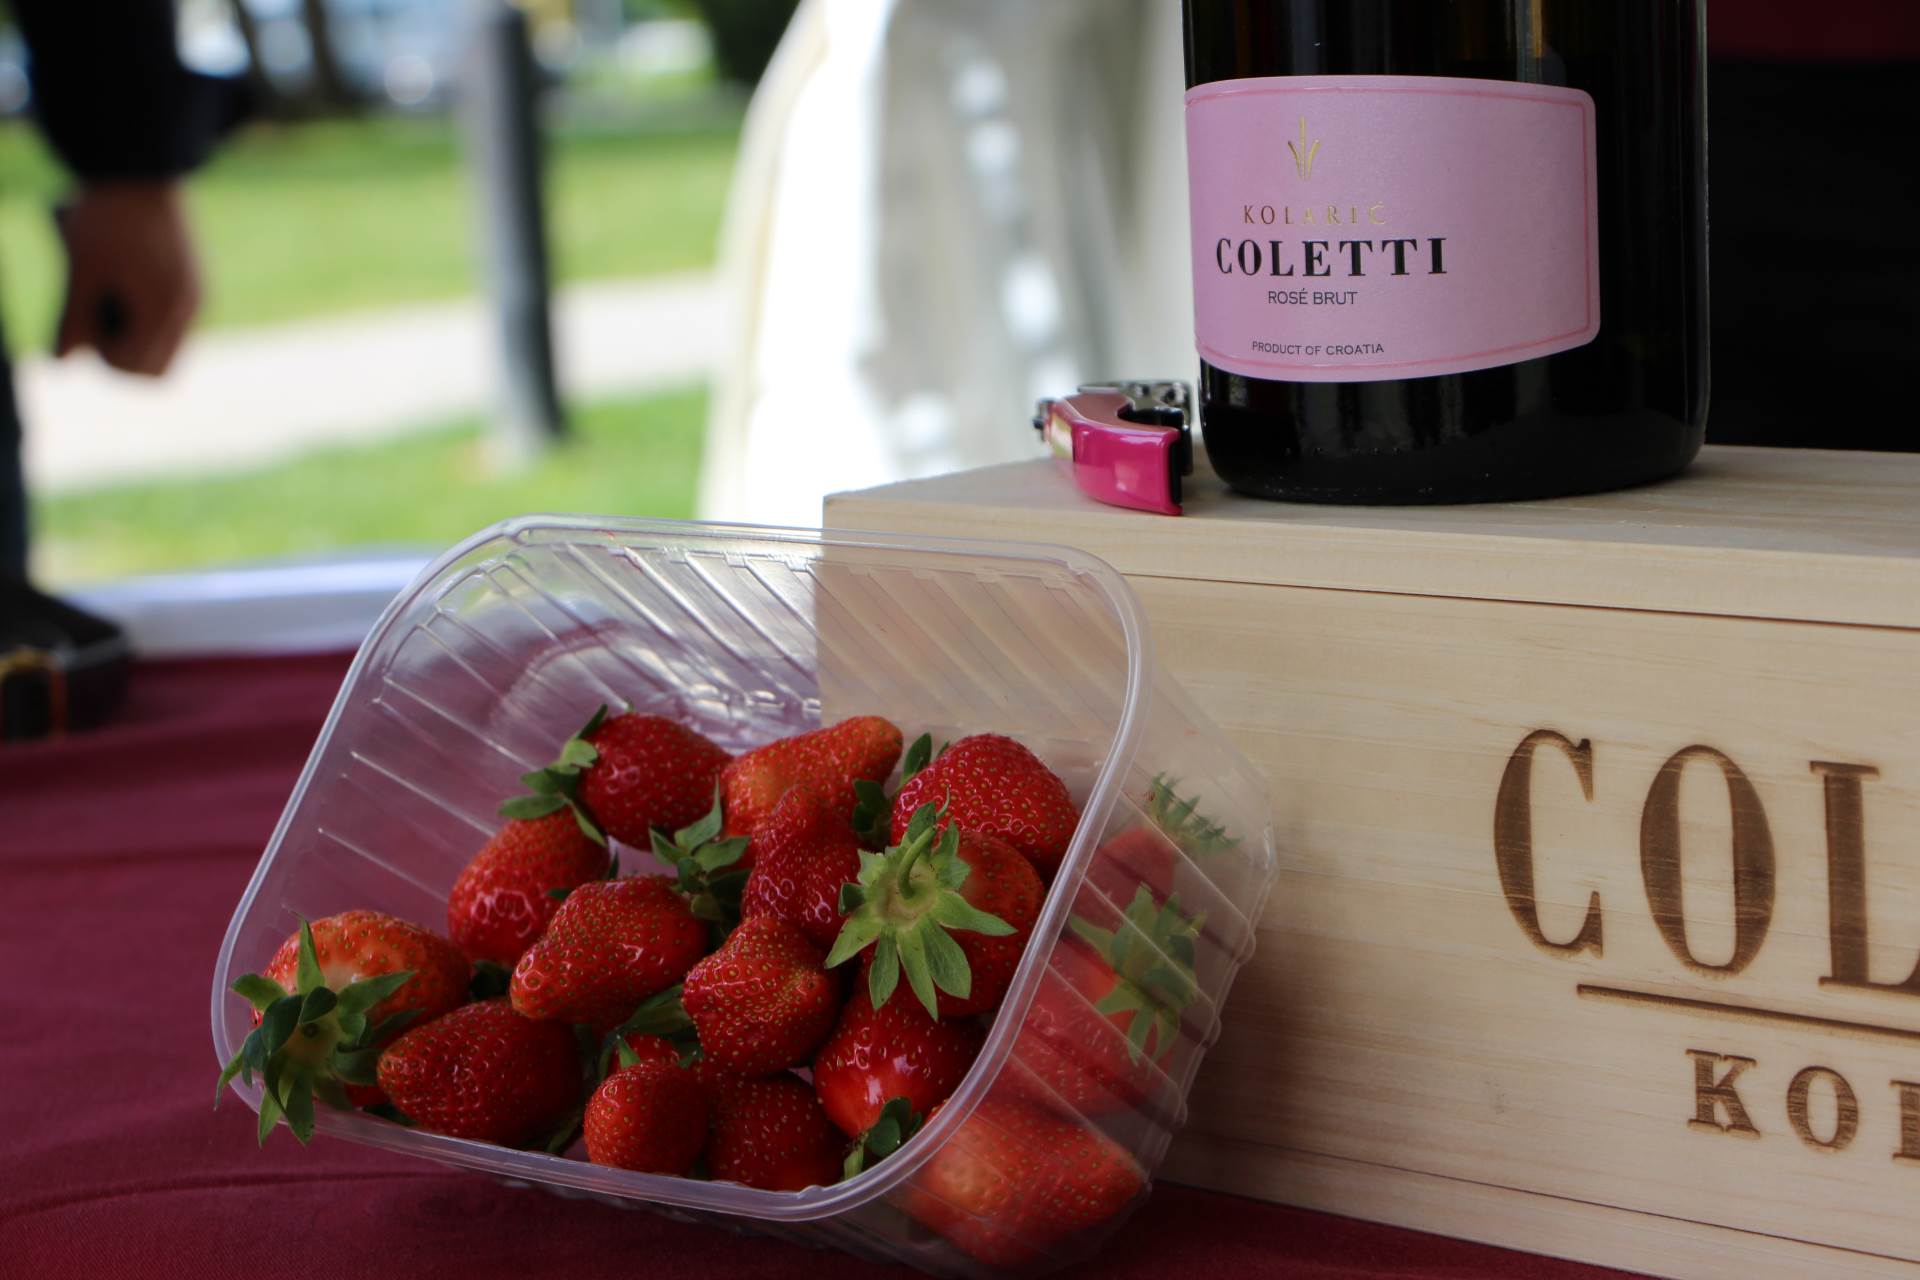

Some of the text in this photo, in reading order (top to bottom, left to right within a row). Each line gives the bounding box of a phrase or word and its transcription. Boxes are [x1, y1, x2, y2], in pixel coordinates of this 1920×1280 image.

[1216, 237, 1447, 277] COLETTI
[1268, 288, 1358, 305] ROSÉ BRUT
[1252, 341, 1385, 356] PRODUCT OF CROATIA
[1494, 728, 1920, 996] COL
